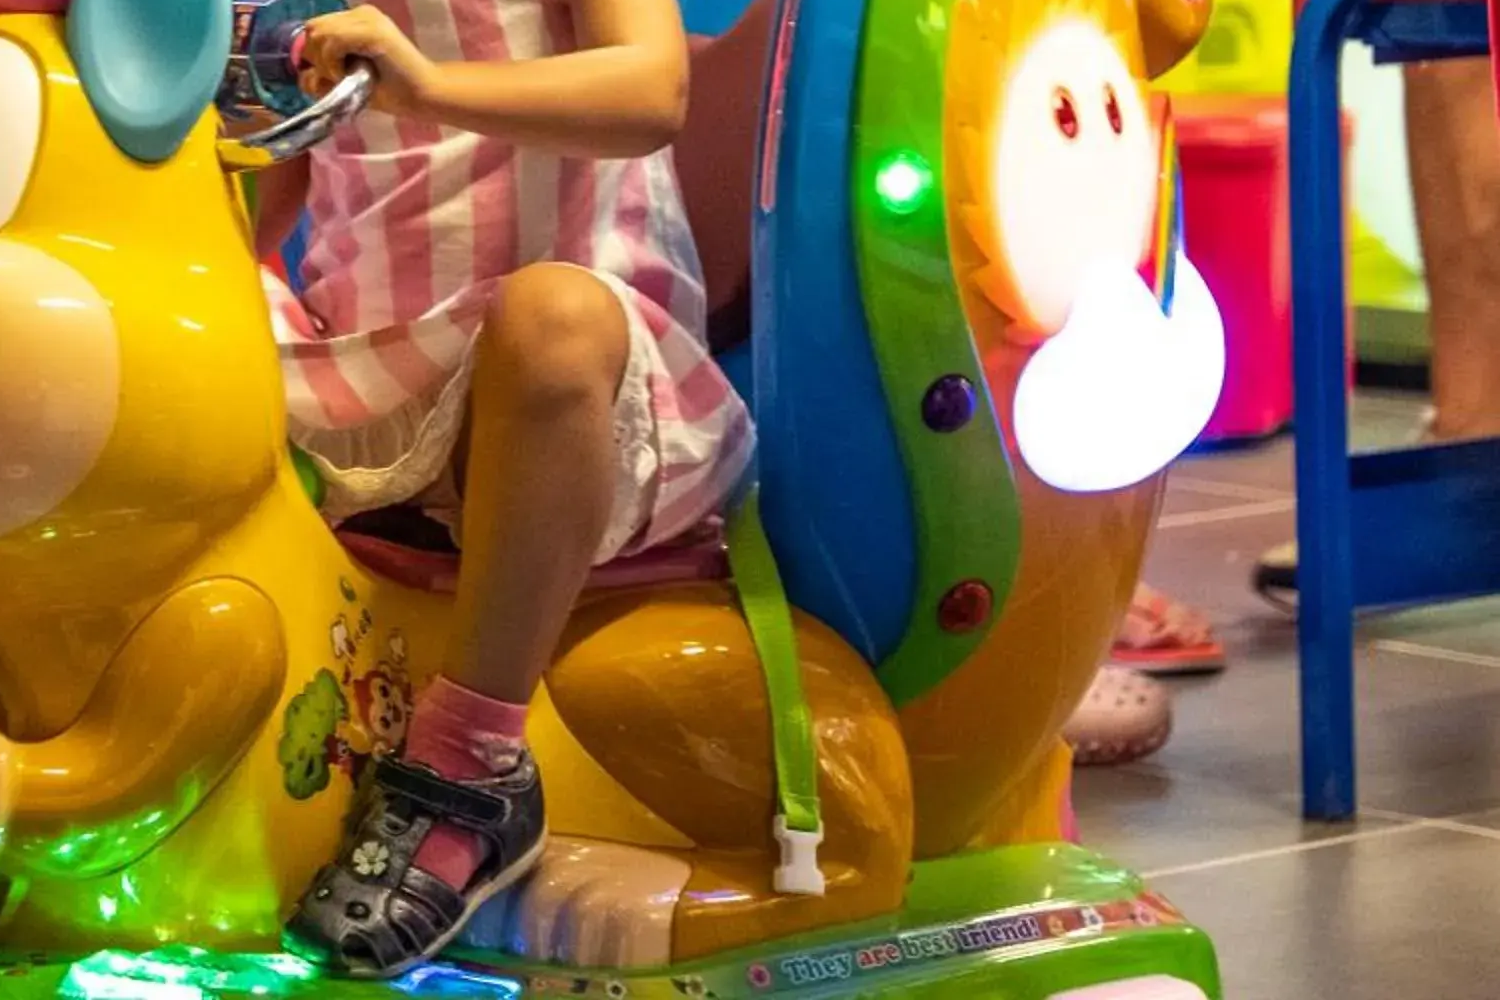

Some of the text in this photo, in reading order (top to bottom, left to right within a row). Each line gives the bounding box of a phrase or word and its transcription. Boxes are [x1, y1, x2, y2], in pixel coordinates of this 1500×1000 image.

[783, 916, 1039, 983] They are best friend!
